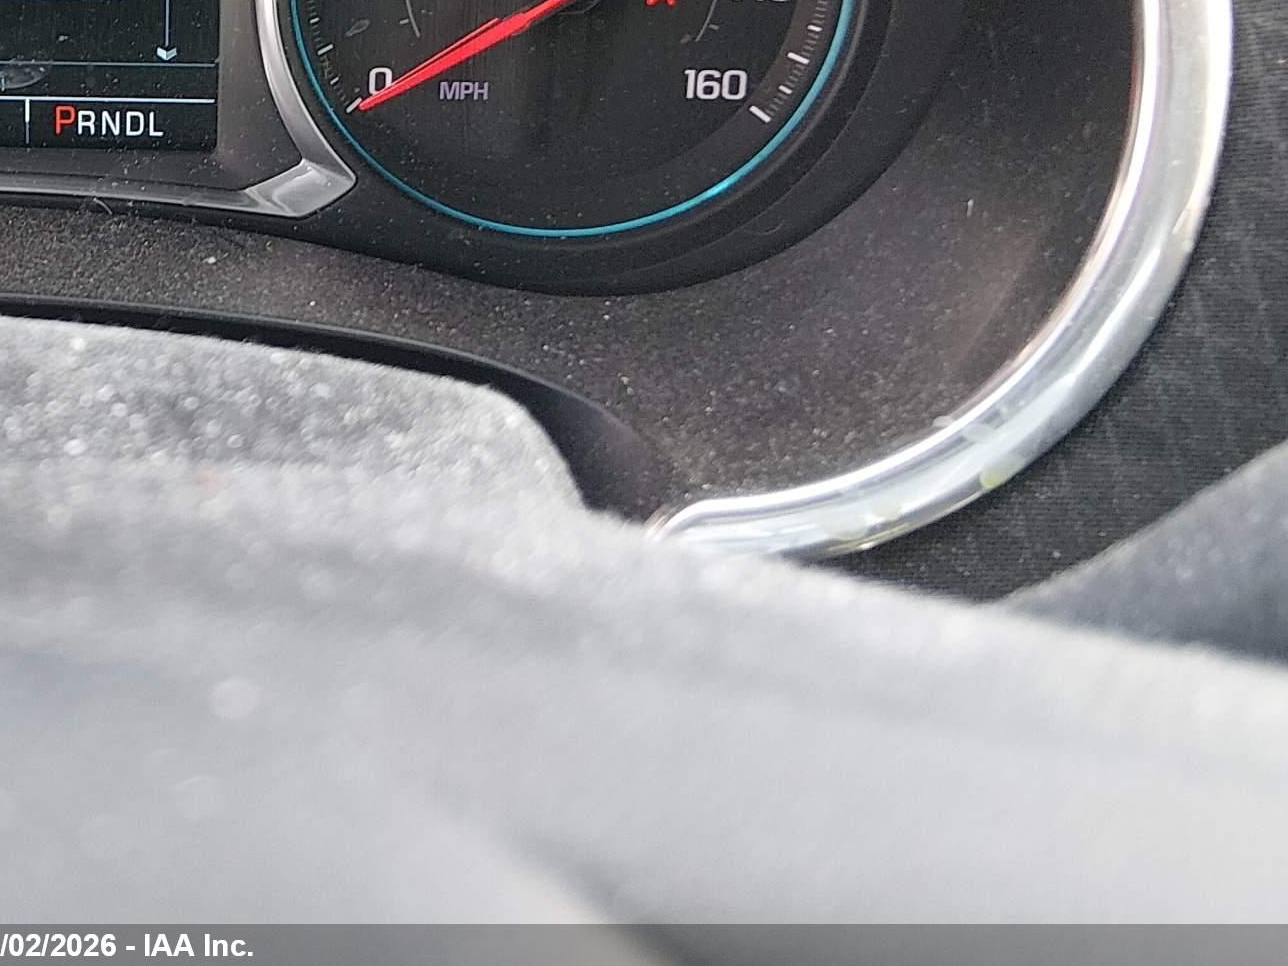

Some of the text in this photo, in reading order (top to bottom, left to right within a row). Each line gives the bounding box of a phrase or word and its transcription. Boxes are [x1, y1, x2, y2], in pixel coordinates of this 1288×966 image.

[368, 67, 393, 96] 0
[439, 81, 489, 101] MPH
[684, 69, 748, 100] 160
[55, 105, 164, 137] PRNDL
